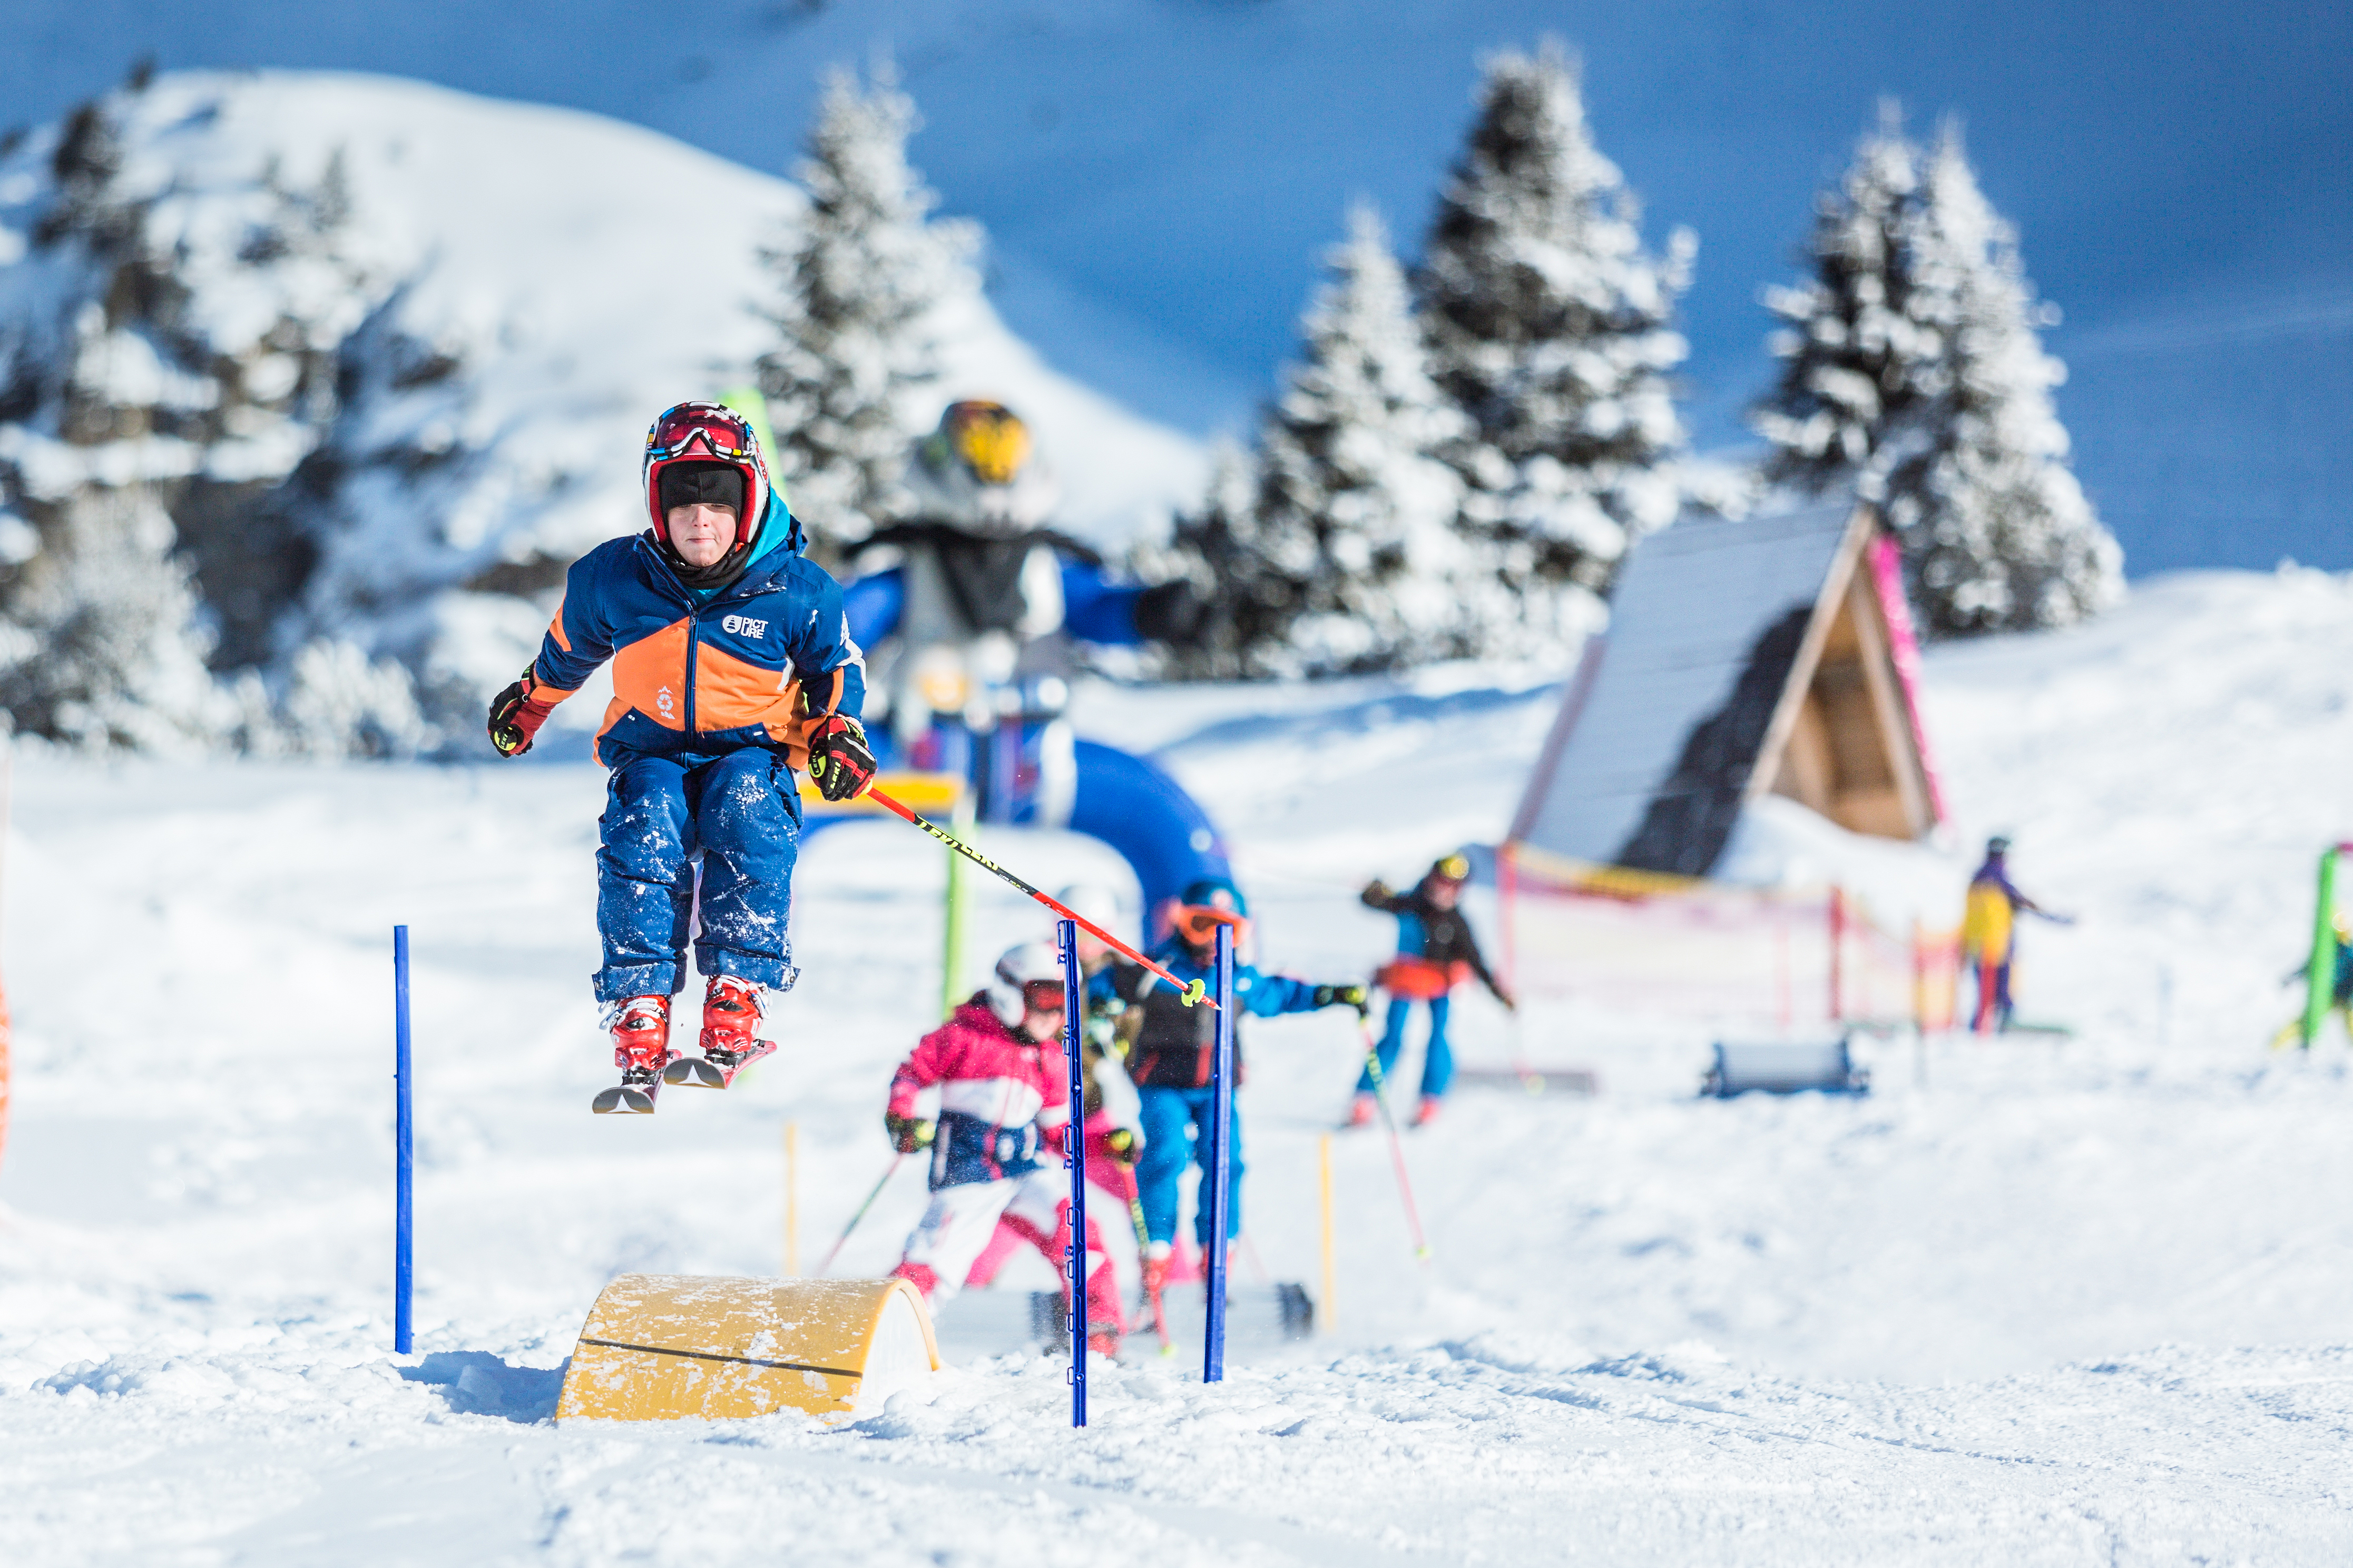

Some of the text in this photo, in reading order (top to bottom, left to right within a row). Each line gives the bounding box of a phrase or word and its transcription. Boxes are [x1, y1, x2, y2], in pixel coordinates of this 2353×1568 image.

[743, 617, 769, 631] PICT
[740, 627, 765, 639] URE
[830, 762, 841, 789] LEKI
